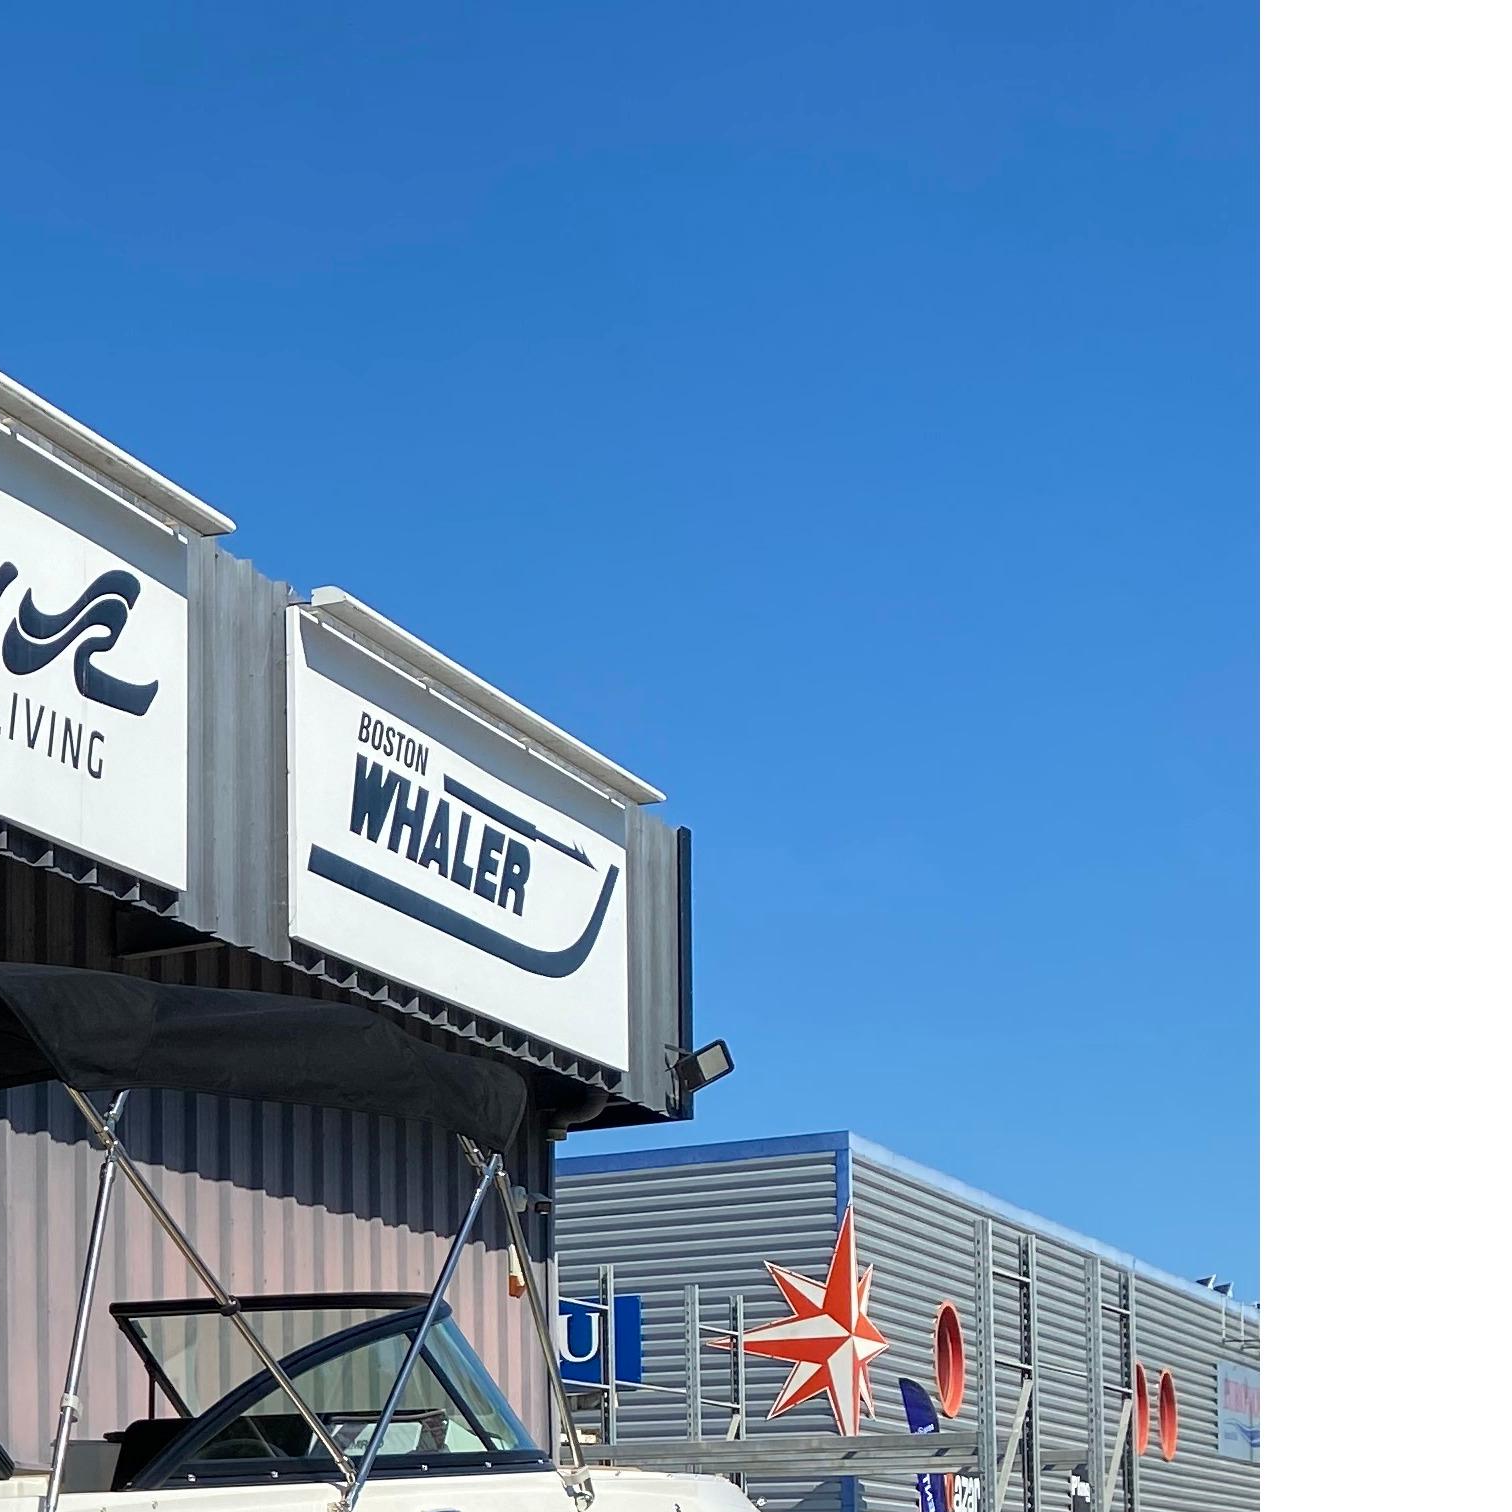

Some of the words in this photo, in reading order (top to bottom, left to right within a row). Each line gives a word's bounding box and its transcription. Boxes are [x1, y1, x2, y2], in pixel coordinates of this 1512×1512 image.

[357, 710, 430, 777] BOSTON
[349, 752, 532, 917] WHALER
[556, 1312, 601, 1363] U
